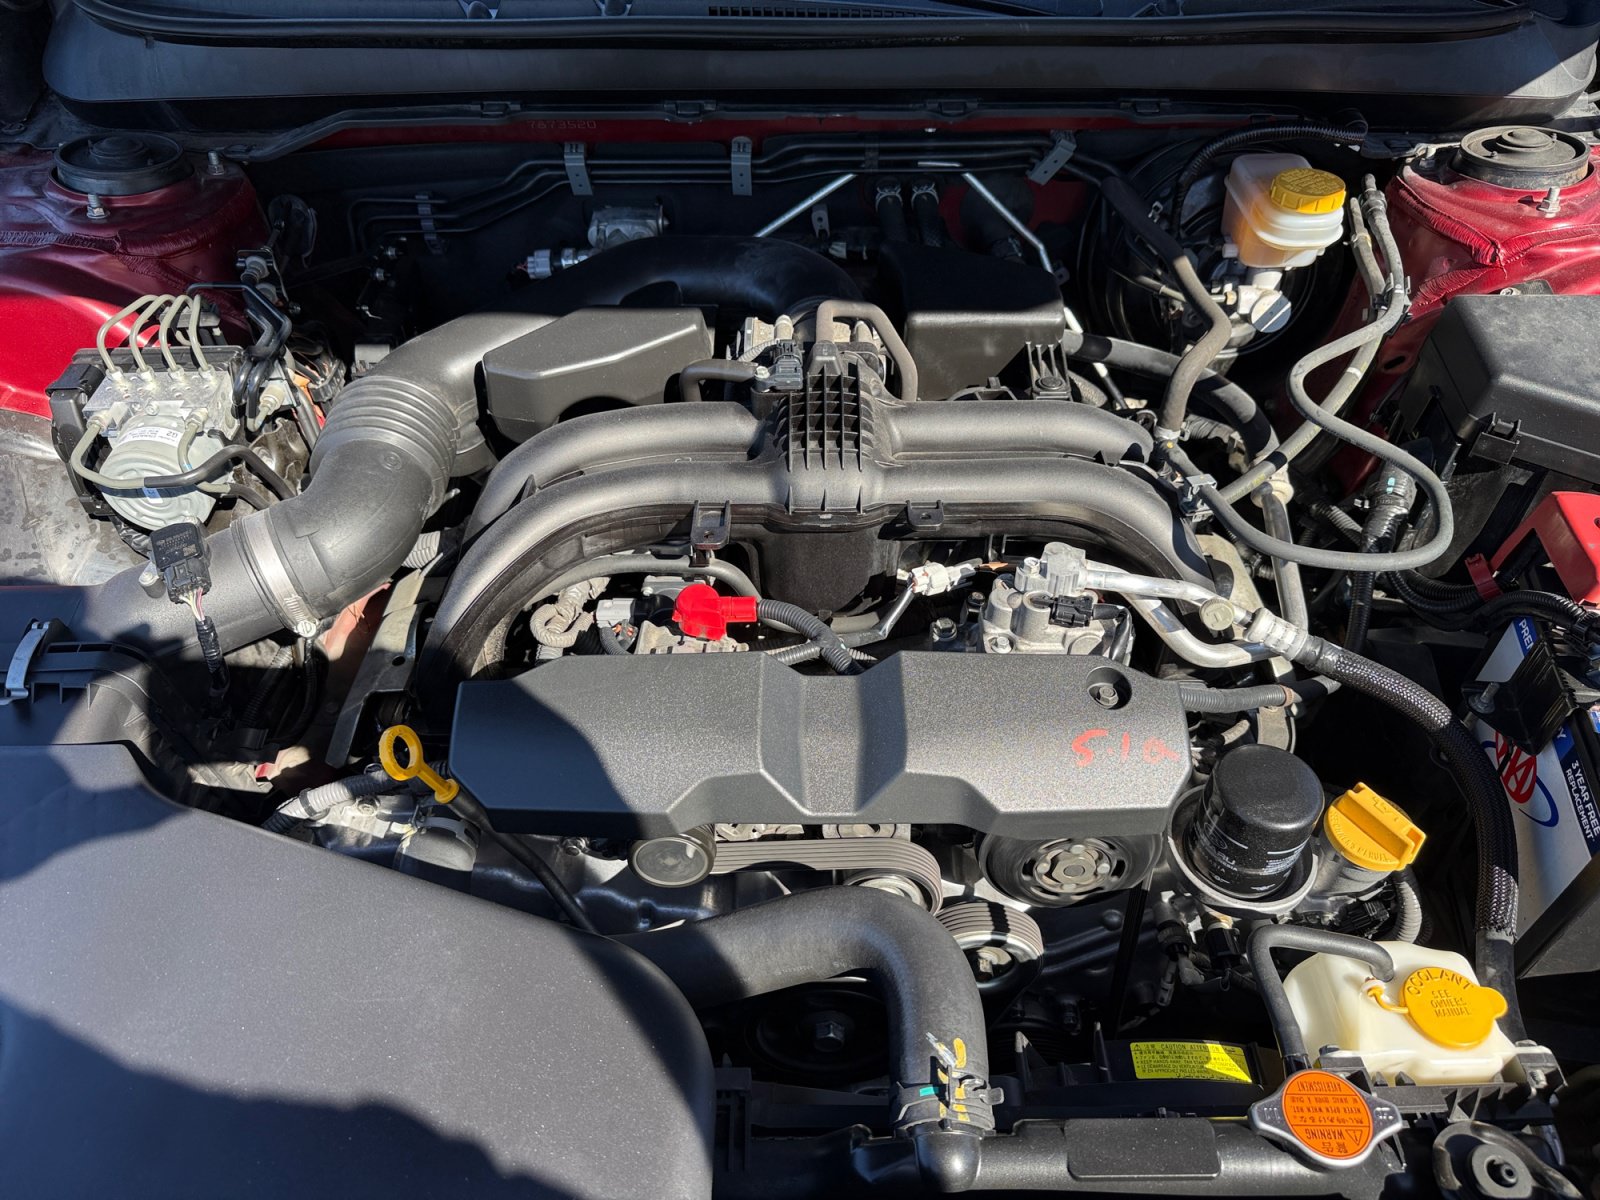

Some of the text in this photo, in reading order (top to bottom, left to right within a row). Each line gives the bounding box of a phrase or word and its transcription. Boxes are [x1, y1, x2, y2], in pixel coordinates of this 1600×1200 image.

[1572, 760, 1600, 836] 3 YEAR FREE
[1406, 969, 1474, 996] COOLANT
[1432, 990, 1452, 998] SEE
[1434, 1007, 1470, 1017] MANUAL
[1305, 1128, 1345, 1140] WARNING
